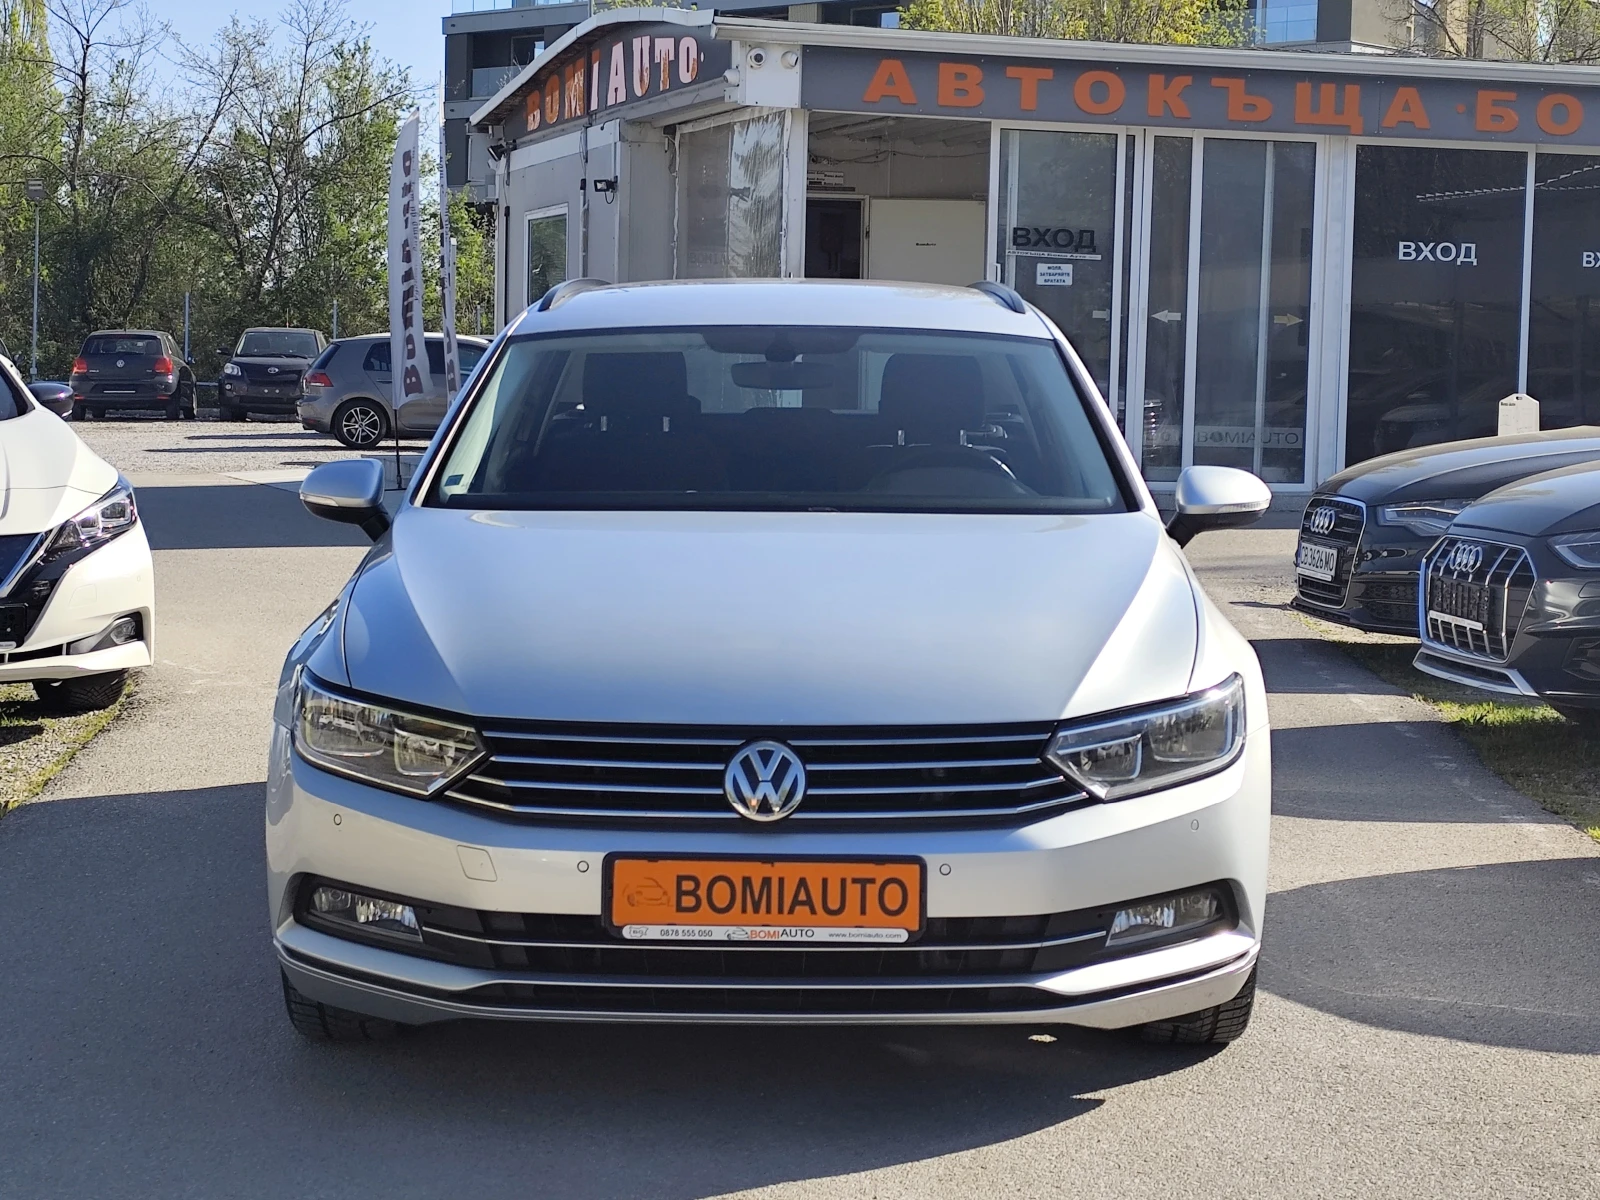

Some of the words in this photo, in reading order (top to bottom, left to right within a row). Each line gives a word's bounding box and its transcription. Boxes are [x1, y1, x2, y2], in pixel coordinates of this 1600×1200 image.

[862, 59, 1431, 135] АВТОКЪЩА
[1013, 227, 1096, 253] ВХОД
[1399, 241, 1478, 266] ВХОД
[675, 874, 909, 917] BOMIAUTO
[660, 929, 680, 937] 0878
[698, 930, 713, 938] 050
[828, 931, 902, 939] www.bomiauto.com
